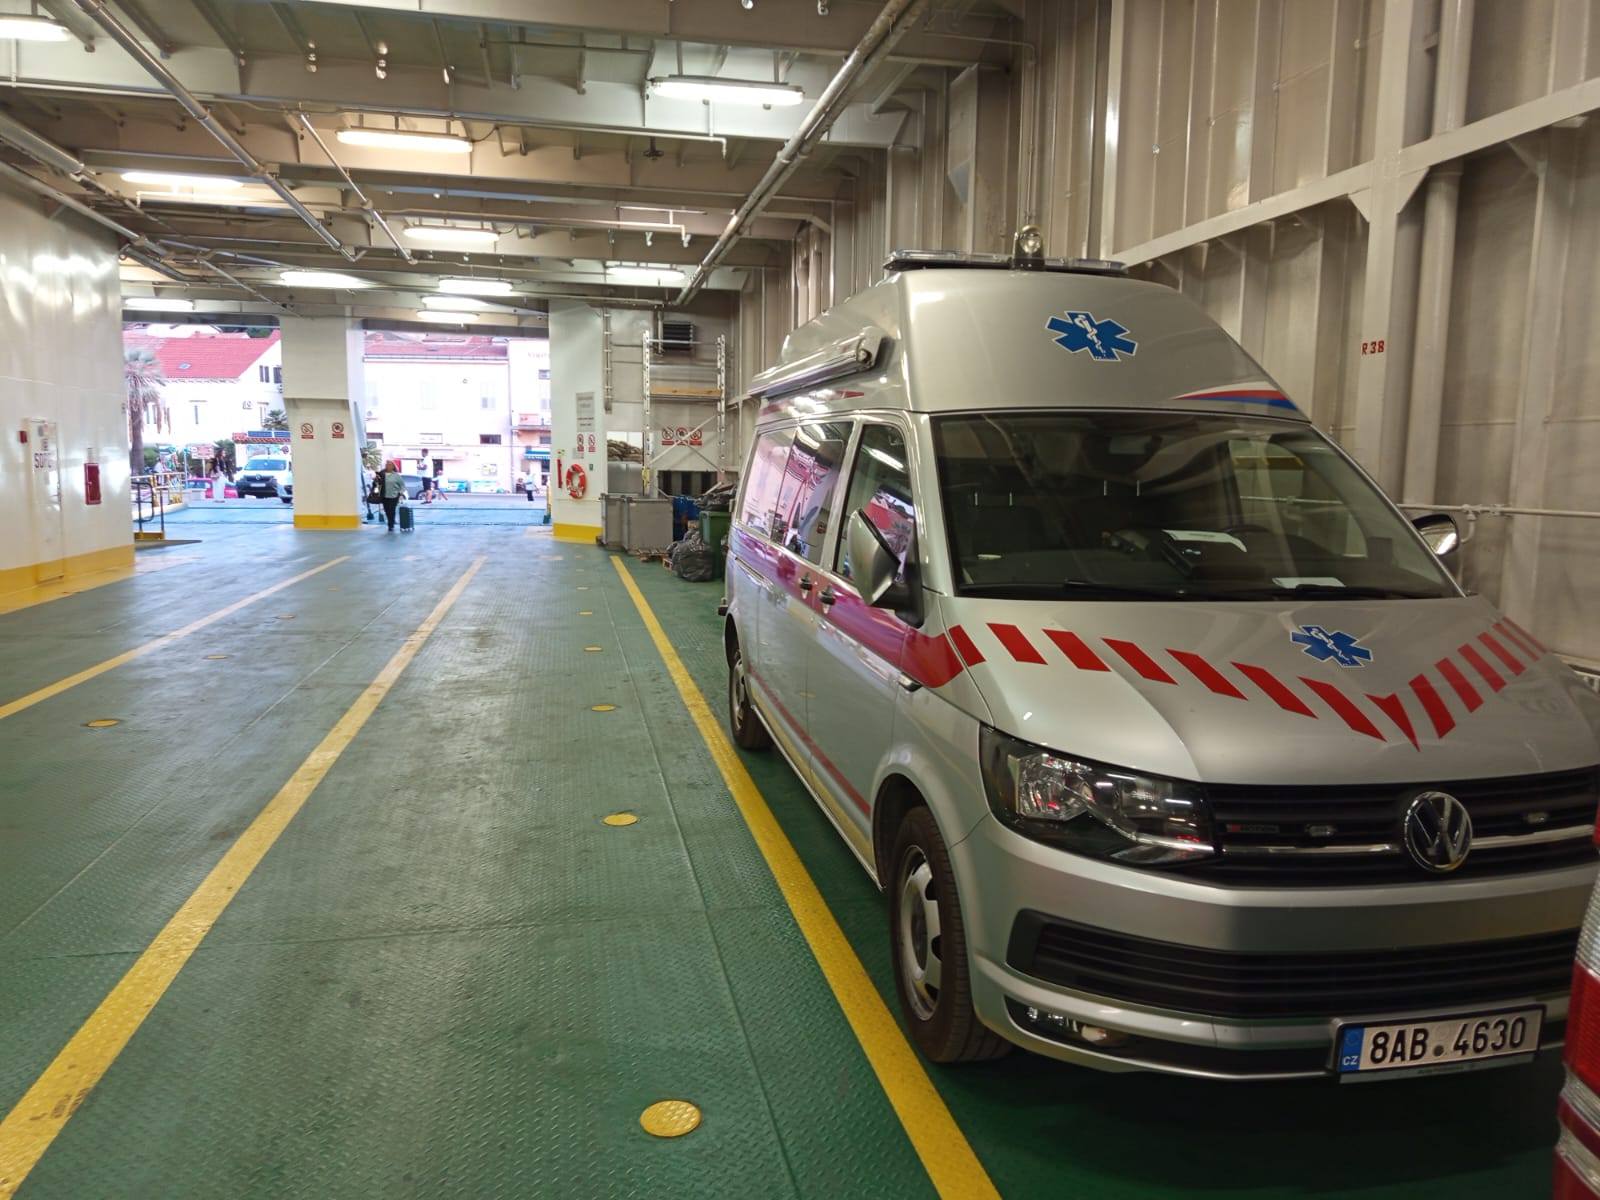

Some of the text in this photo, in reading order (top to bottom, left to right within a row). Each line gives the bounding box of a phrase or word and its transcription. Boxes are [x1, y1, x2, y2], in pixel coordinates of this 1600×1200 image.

[1369, 1016, 1527, 1065] 8AB 4630
[1342, 1055, 1359, 1066] CZ
